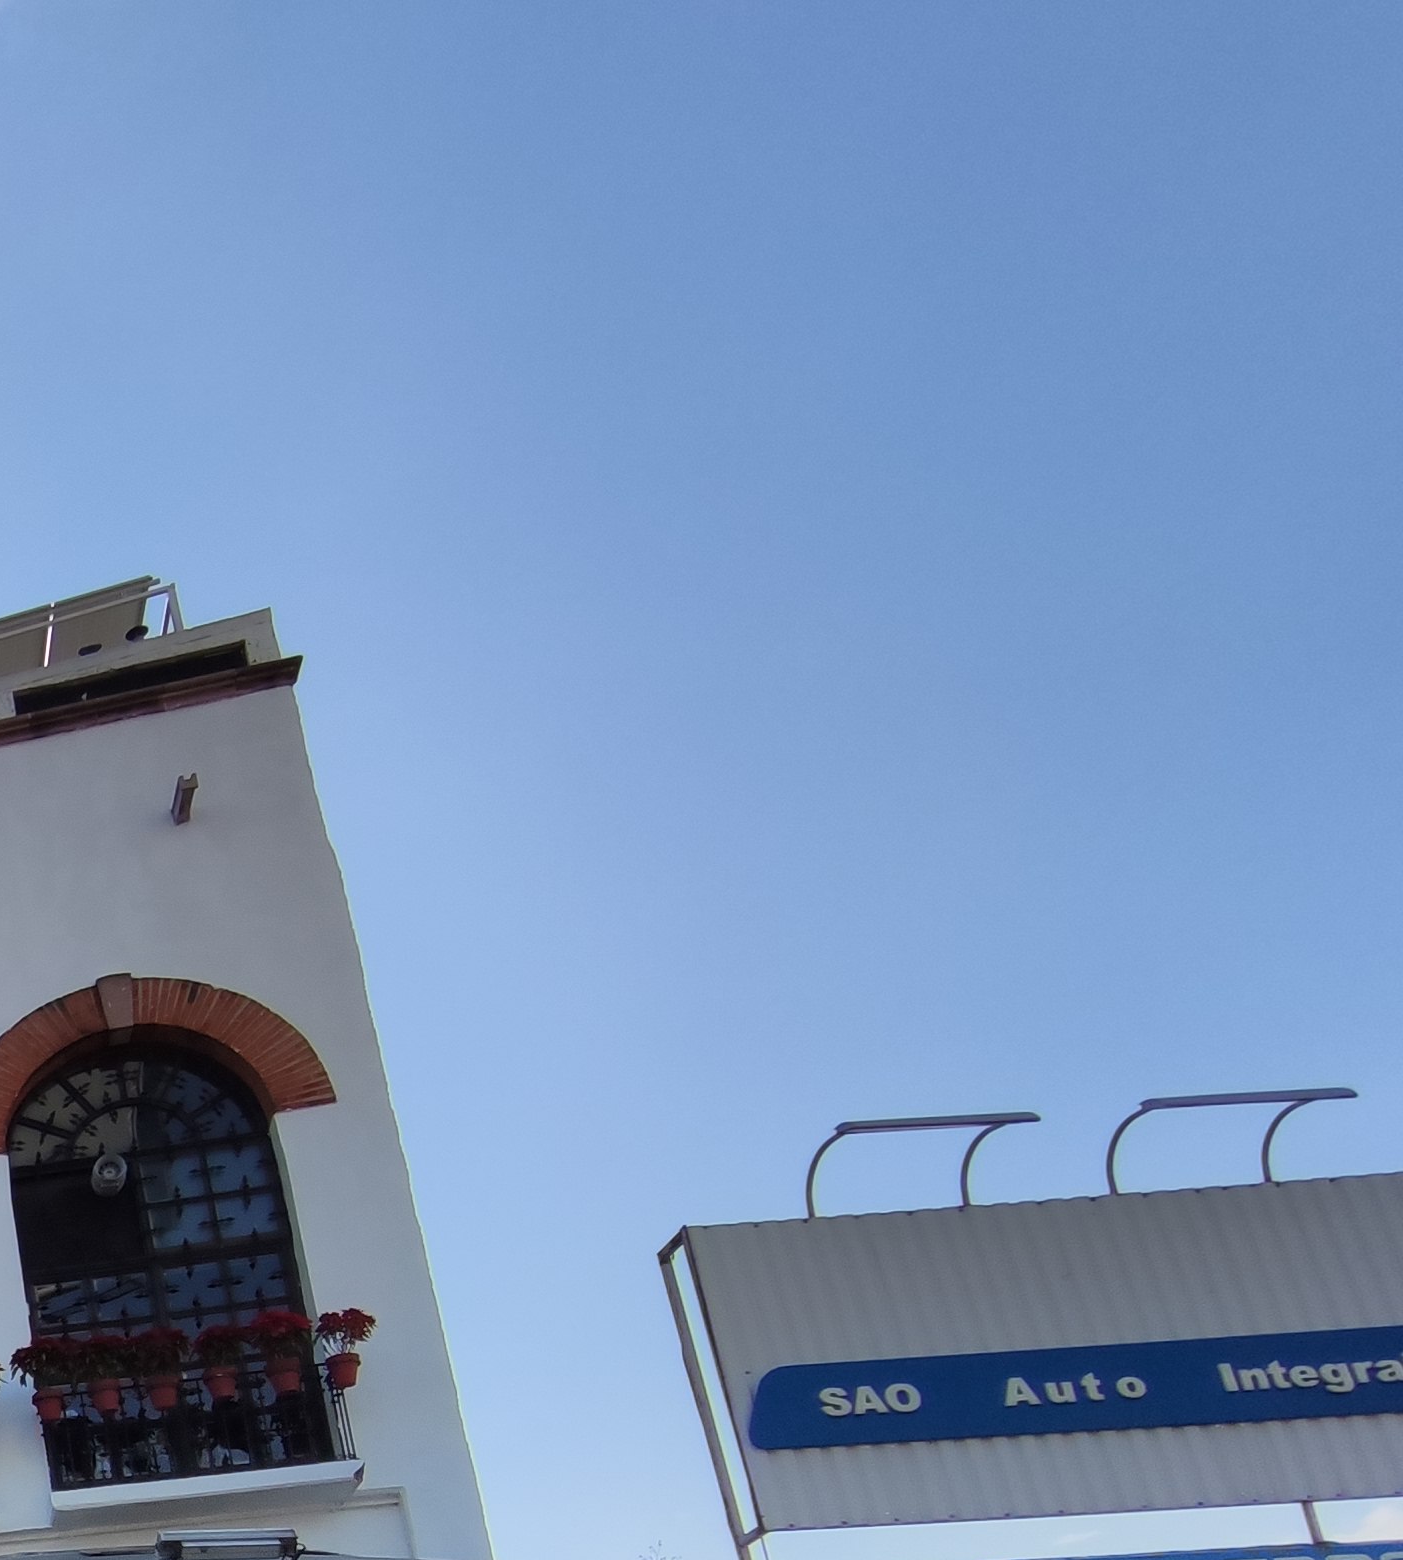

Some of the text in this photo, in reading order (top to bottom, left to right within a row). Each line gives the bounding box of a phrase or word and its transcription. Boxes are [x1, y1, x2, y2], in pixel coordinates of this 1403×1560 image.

[818, 1353, 1403, 1418] SAO Auto Integra
